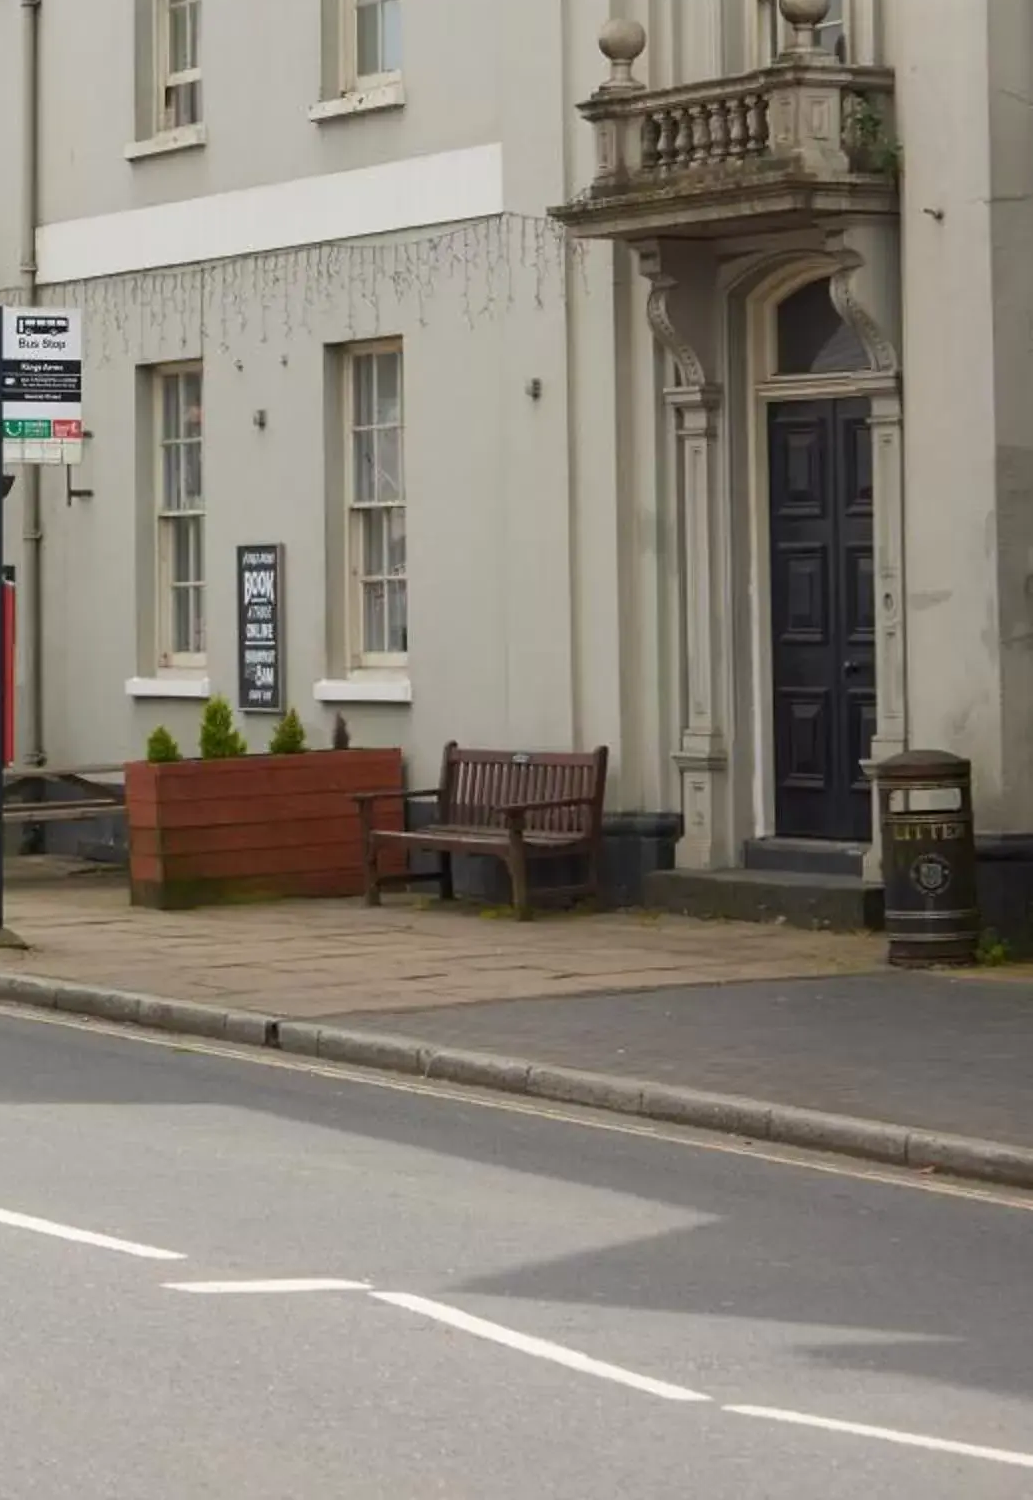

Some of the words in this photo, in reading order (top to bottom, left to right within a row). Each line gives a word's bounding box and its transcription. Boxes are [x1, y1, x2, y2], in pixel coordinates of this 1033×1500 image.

[18, 338, 40, 350] Bus
[42, 337, 67, 352] Stop
[244, 570, 275, 605] BOOK
